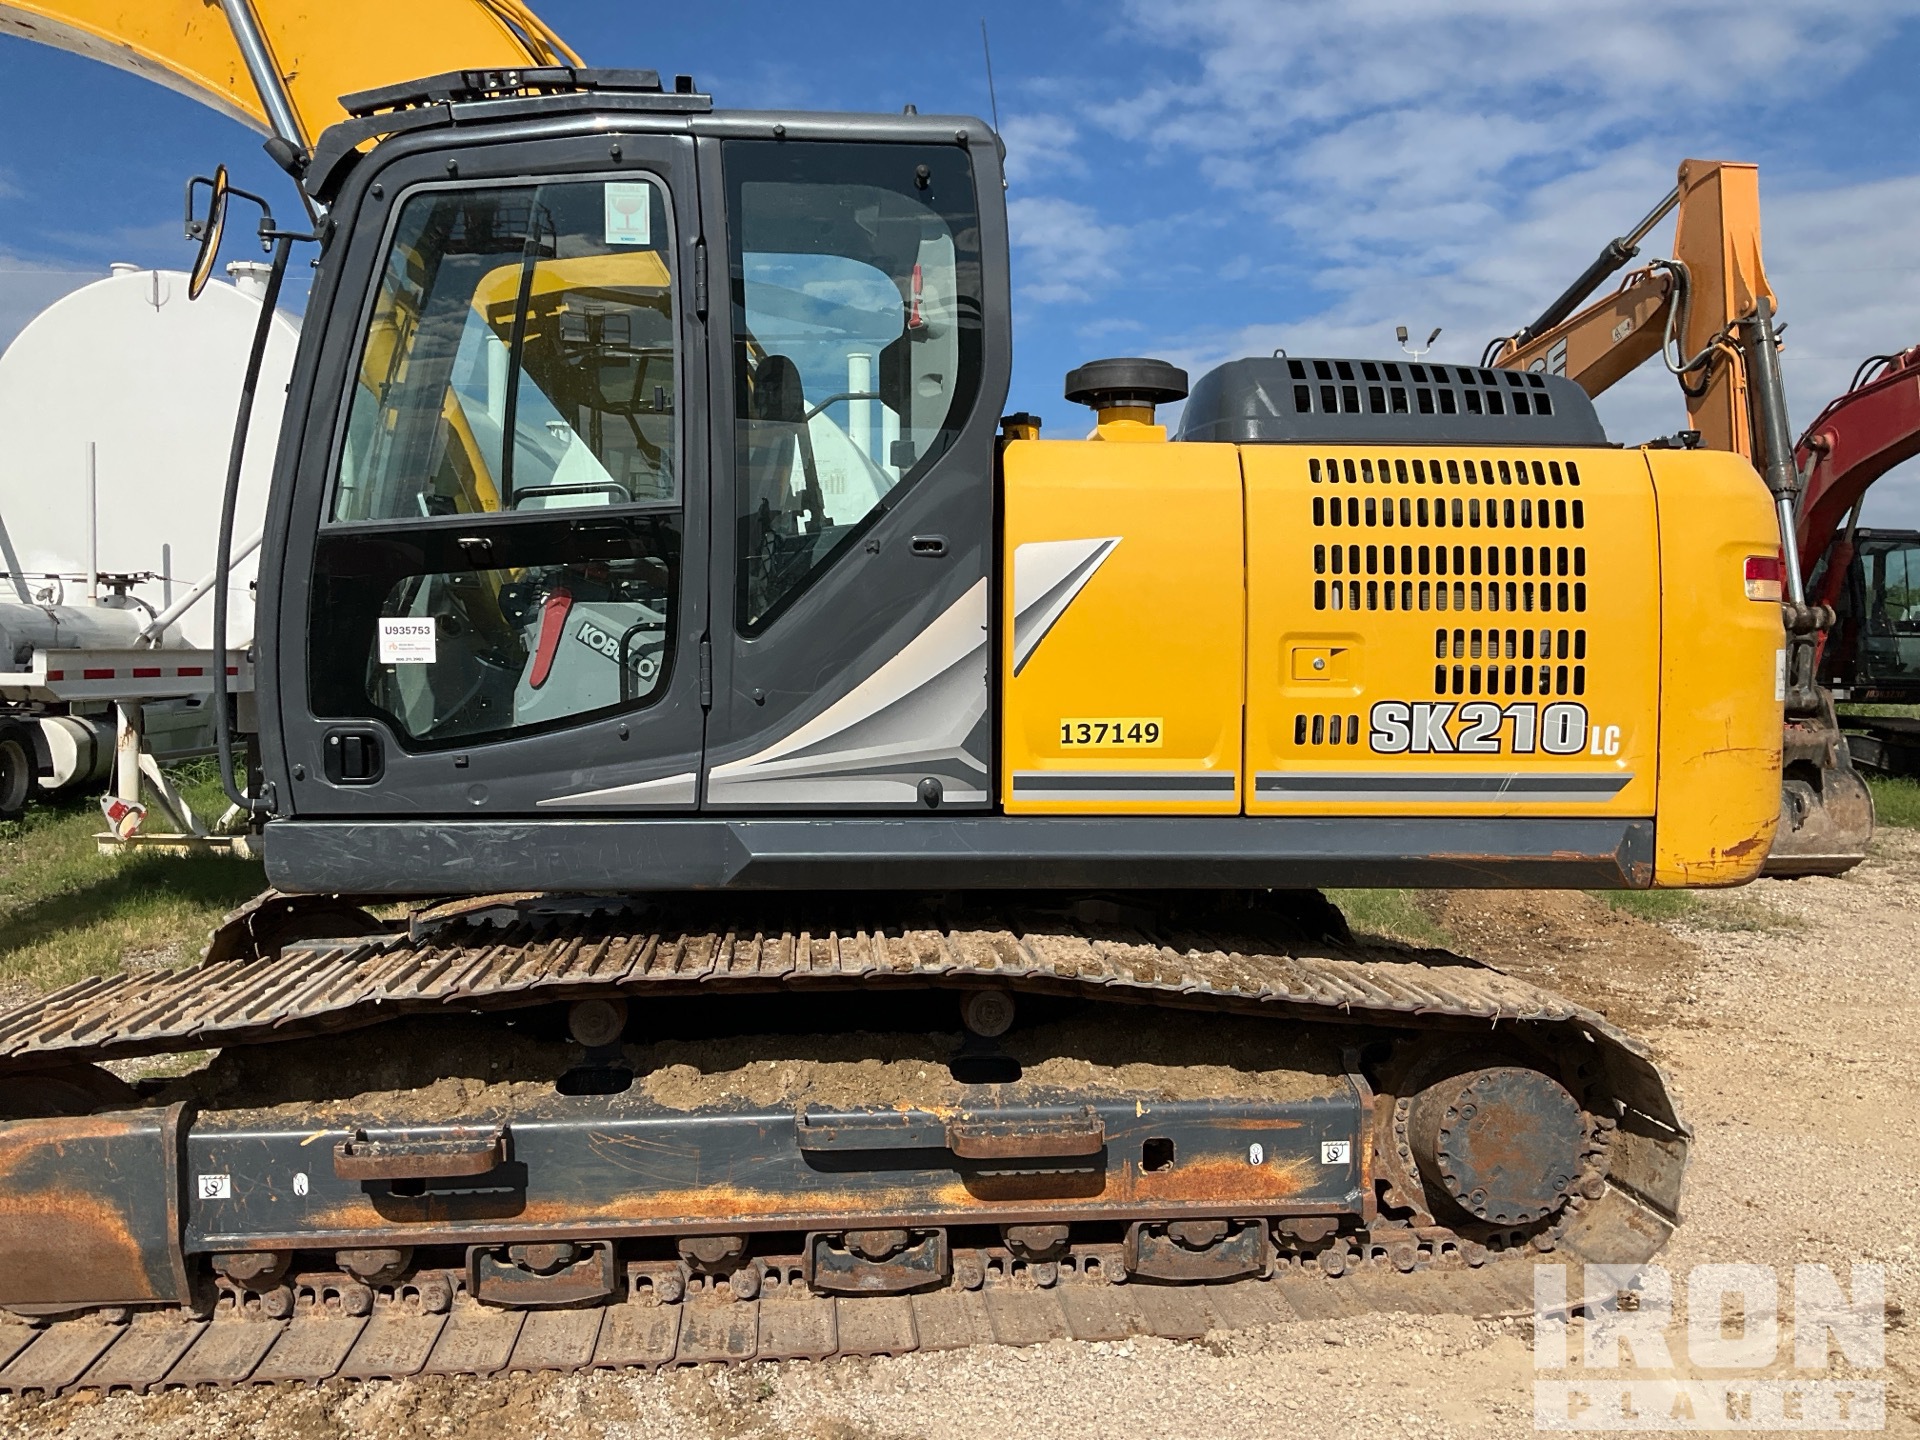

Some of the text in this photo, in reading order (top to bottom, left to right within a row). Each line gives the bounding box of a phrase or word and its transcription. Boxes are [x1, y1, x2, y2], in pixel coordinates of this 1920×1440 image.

[385, 626, 430, 635] U935753
[1061, 723, 1159, 744] 137149
[1369, 701, 1620, 756] SK210 LC
